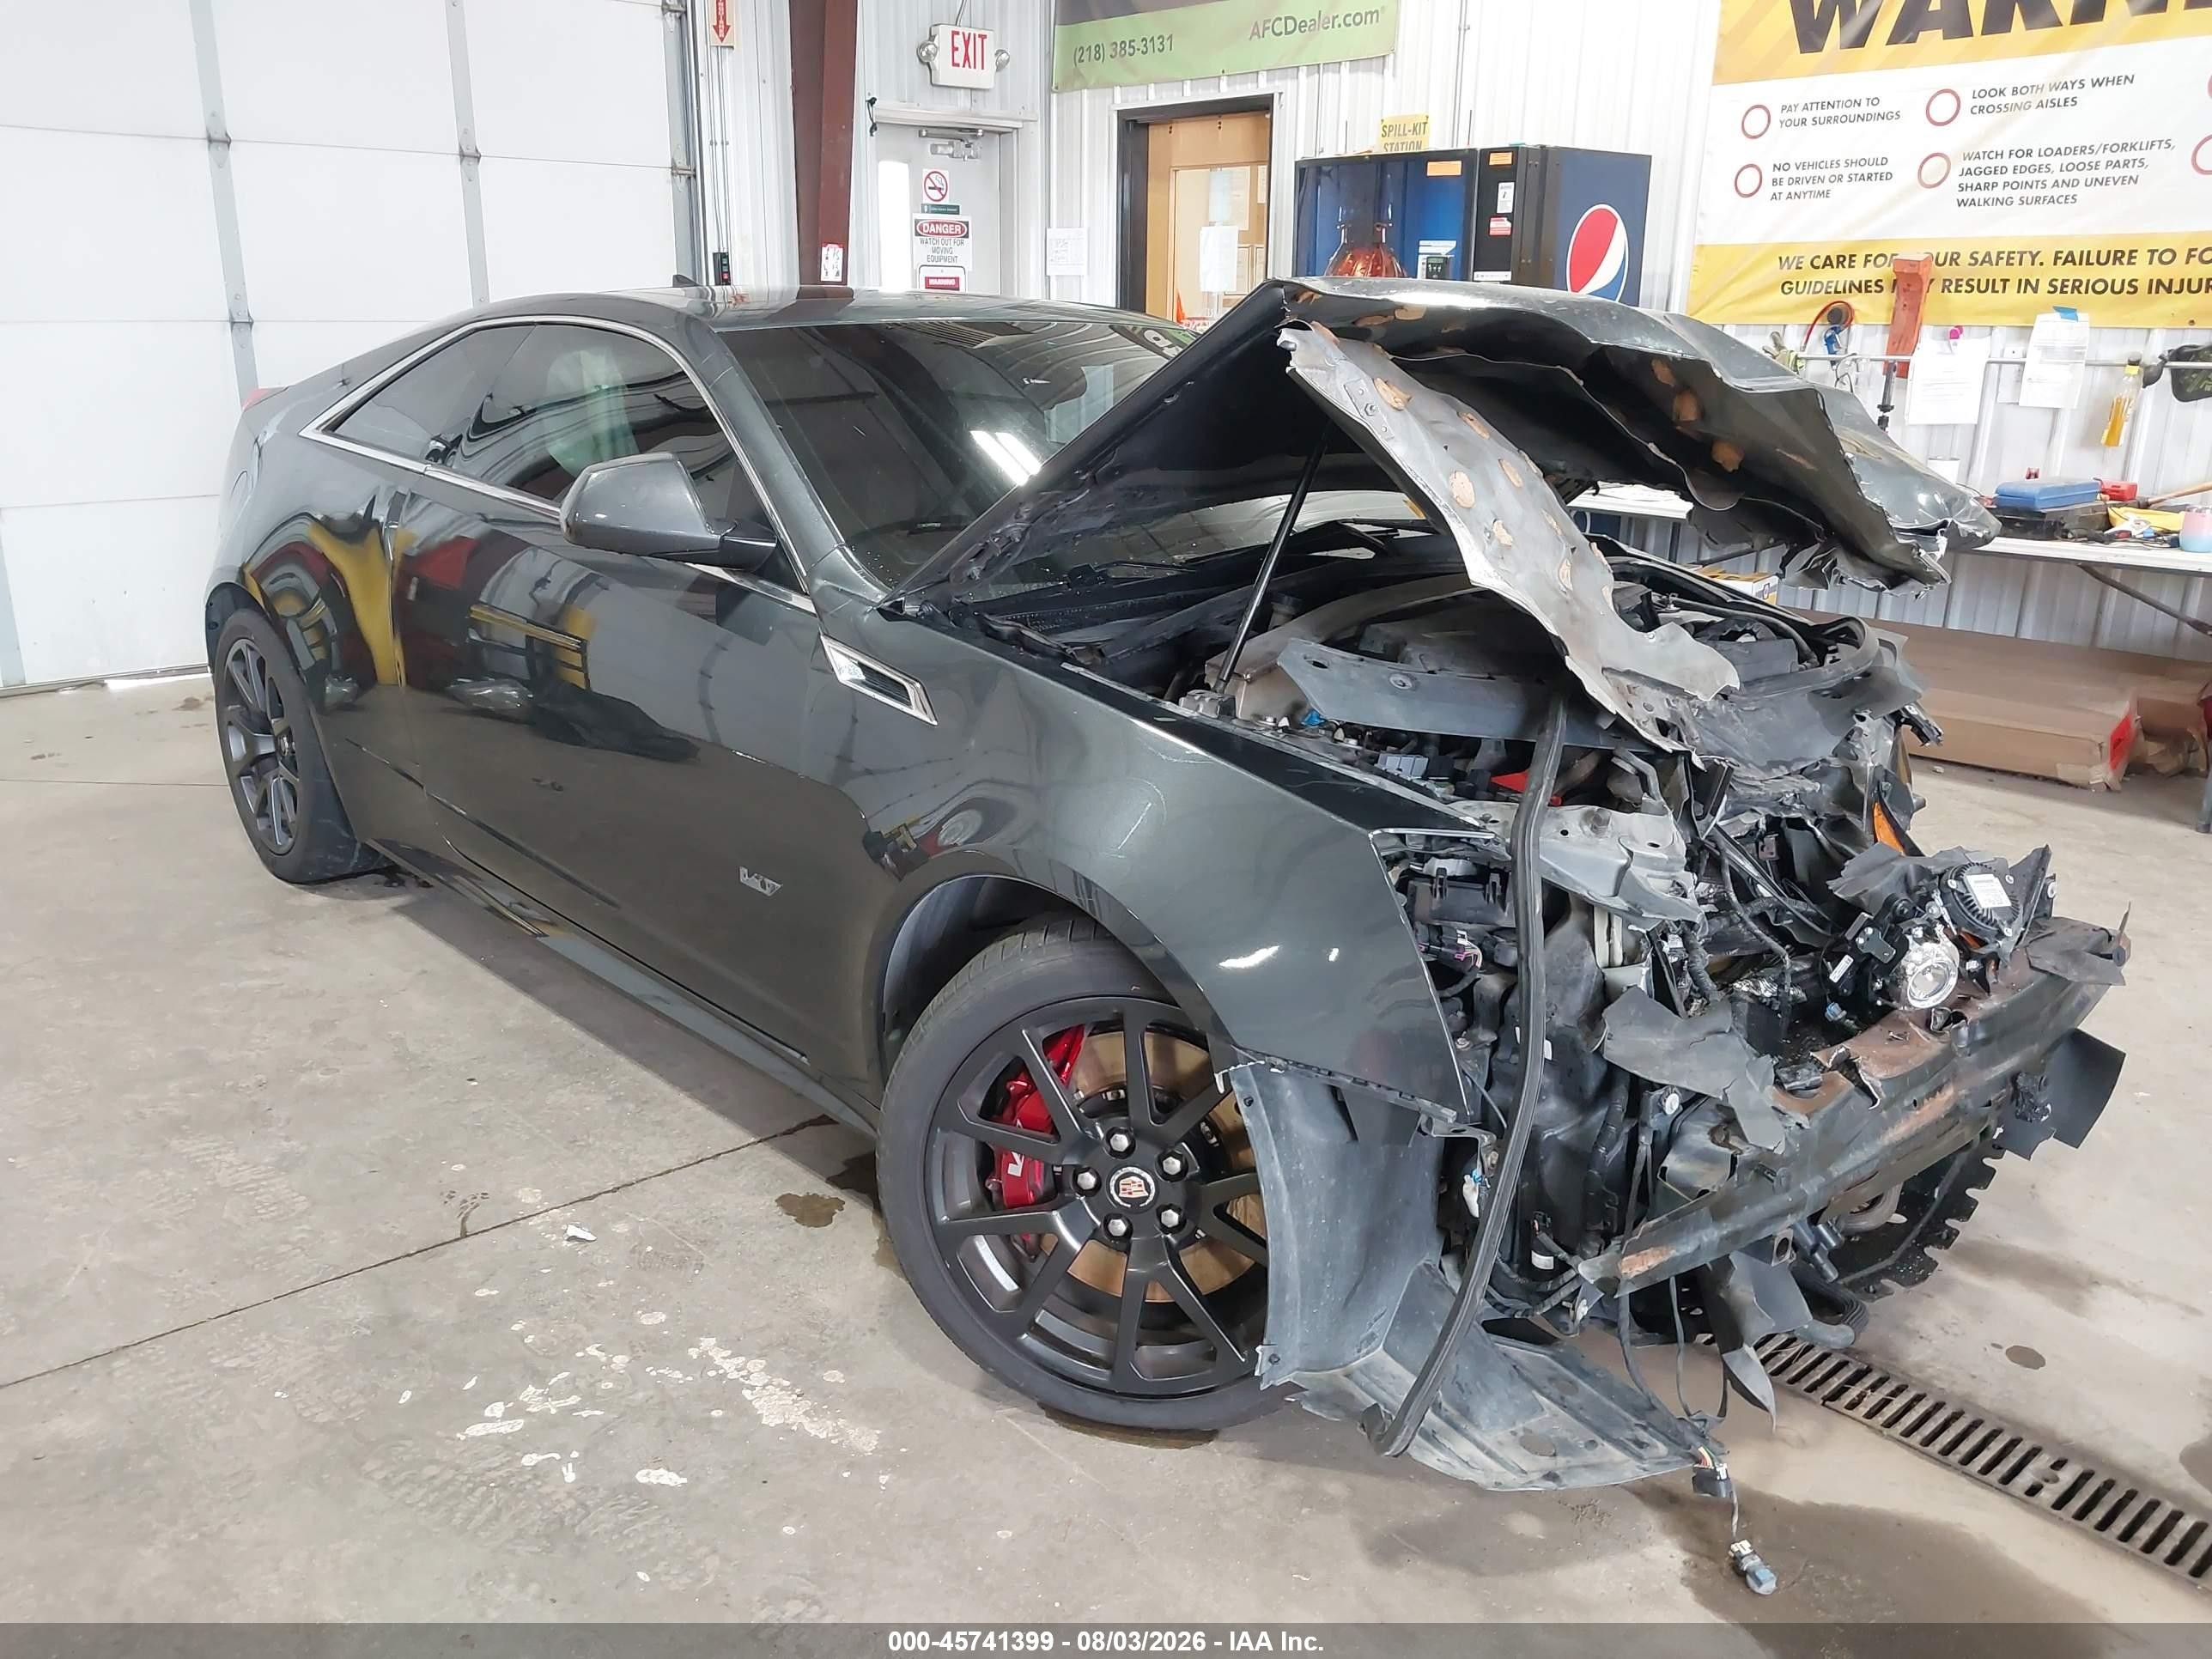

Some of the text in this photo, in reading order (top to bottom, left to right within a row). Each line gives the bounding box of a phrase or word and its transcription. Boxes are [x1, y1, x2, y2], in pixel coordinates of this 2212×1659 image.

[951, 30, 988, 70] EXIT
[1073, 33, 1175, 67] (218) 385-3131
[1972, 75, 2136, 100] LOOK BOTH WAYS WHEN
[1781, 97, 1880, 113] PAY ATTENTION TO
[1971, 96, 2079, 114] CROSSING AISLES
[1779, 111, 1901, 128] YOUR SURROUNDINGS
[1382, 122, 1427, 137] SPILL-KIT
[1383, 141, 1422, 152] STATION
[1962, 138, 2177, 161] WATCH FOR LOADERS/FORKLIFTS,
[1772, 157, 1888, 172] NO VEHICLES SHOULD
[1959, 158, 2149, 177] JAGGED EDGES, LOOSE PARTS,
[1771, 172, 1893, 186] BE DRIVEN OR STARTED
[1958, 174, 2139, 192] SHARP POINTS AND UNEVEN
[1771, 190, 1832, 201] AT ANYTIME
[1956, 194, 2078, 208] WALKING SURFACES
[922, 223, 962, 234] DANGER
[1778, 256, 1803, 270] WE
[1810, 254, 1856, 269] CARE
[1968, 251, 2044, 266] SAFETY.
[2053, 250, 2138, 266] FAILURE
[2147, 248, 2177, 264] TO
[1781, 279, 1884, 295] GUIDELINES
[1941, 278, 2010, 294] RESULT
[2017, 278, 2039, 294] IN
[2047, 278, 2138, 295] SERIOUS
